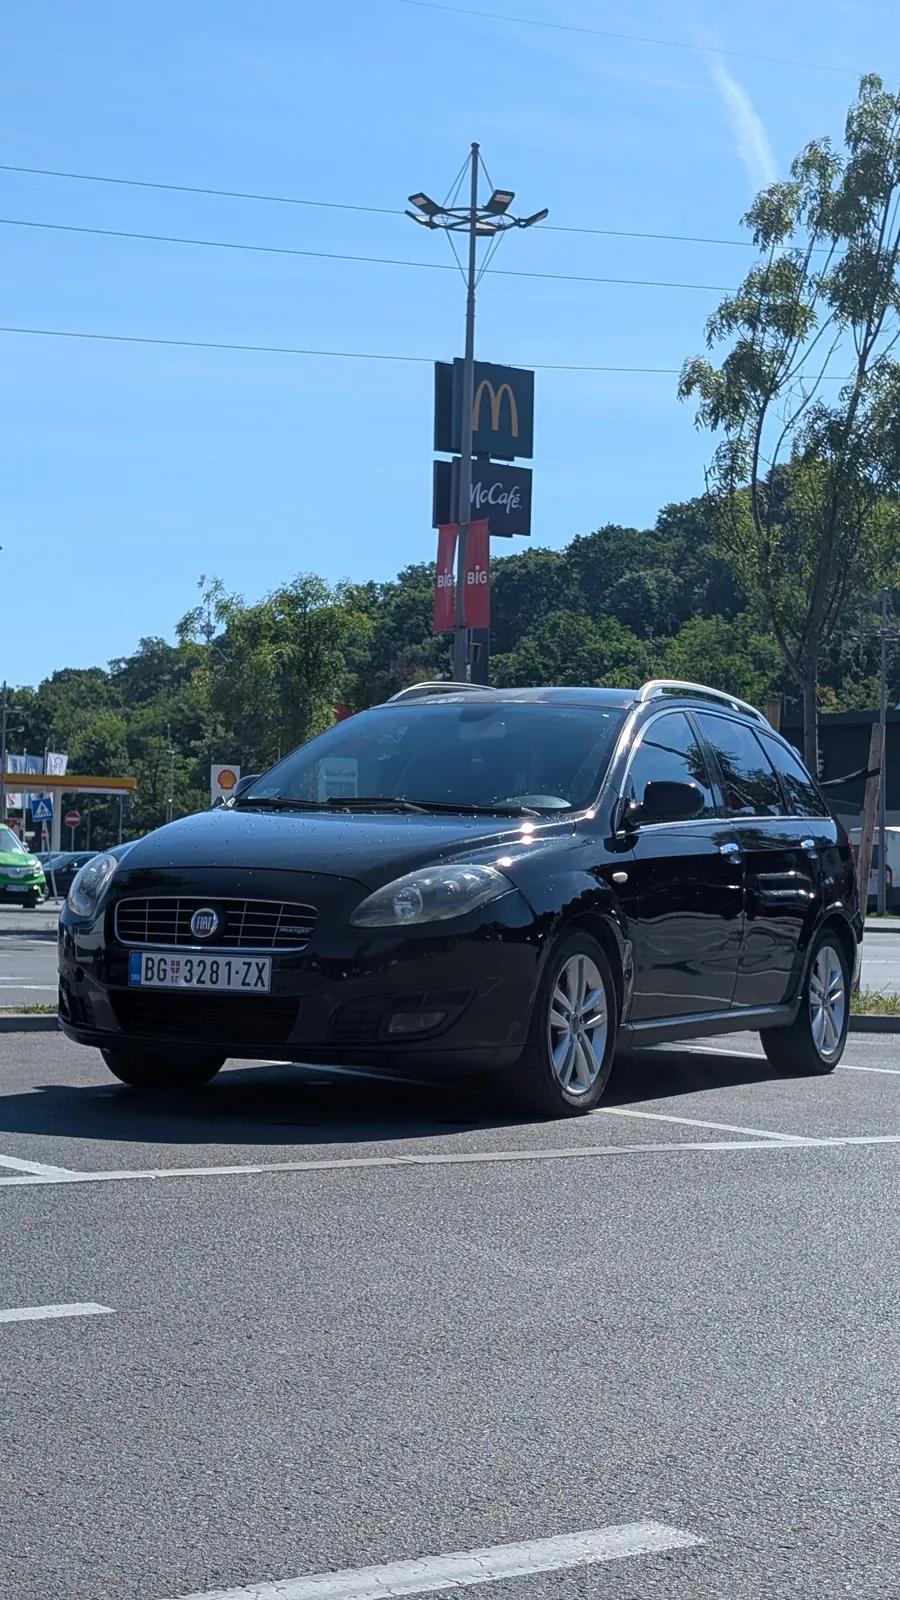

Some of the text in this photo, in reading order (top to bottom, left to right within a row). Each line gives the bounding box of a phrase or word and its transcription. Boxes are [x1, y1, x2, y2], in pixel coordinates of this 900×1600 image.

[469, 482, 520, 514] McCafé
[196, 915, 213, 930] FIAT
[144, 956, 168, 982] BG
